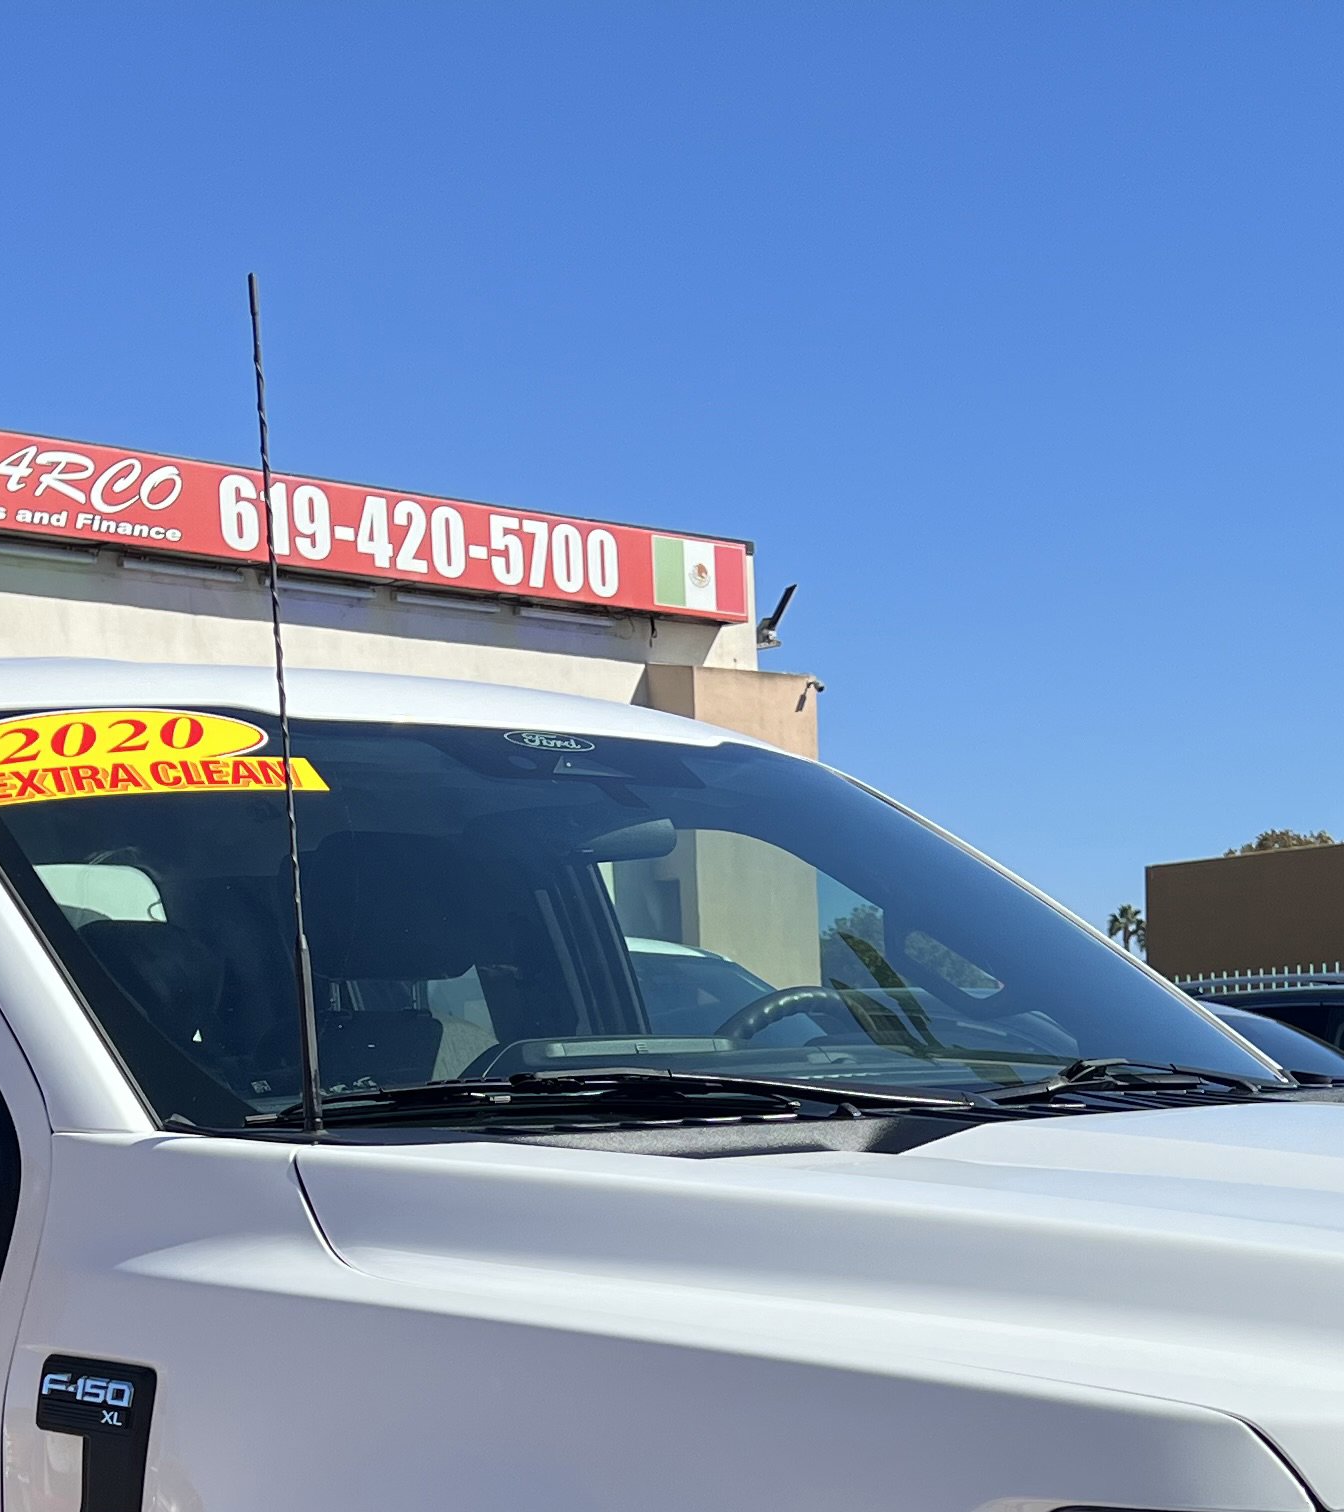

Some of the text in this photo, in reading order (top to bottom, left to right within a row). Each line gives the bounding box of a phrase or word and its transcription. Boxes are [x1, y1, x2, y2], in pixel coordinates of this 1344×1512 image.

[15, 507, 68, 529] and
[76, 512, 183, 542] Finance
[218, 474, 619, 598] 619-420-5700
[521, 732, 582, 749] Ford
[149, 759, 300, 789] CLEAN
[41, 1373, 135, 1408] F-150
[101, 1410, 123, 1426] XL
